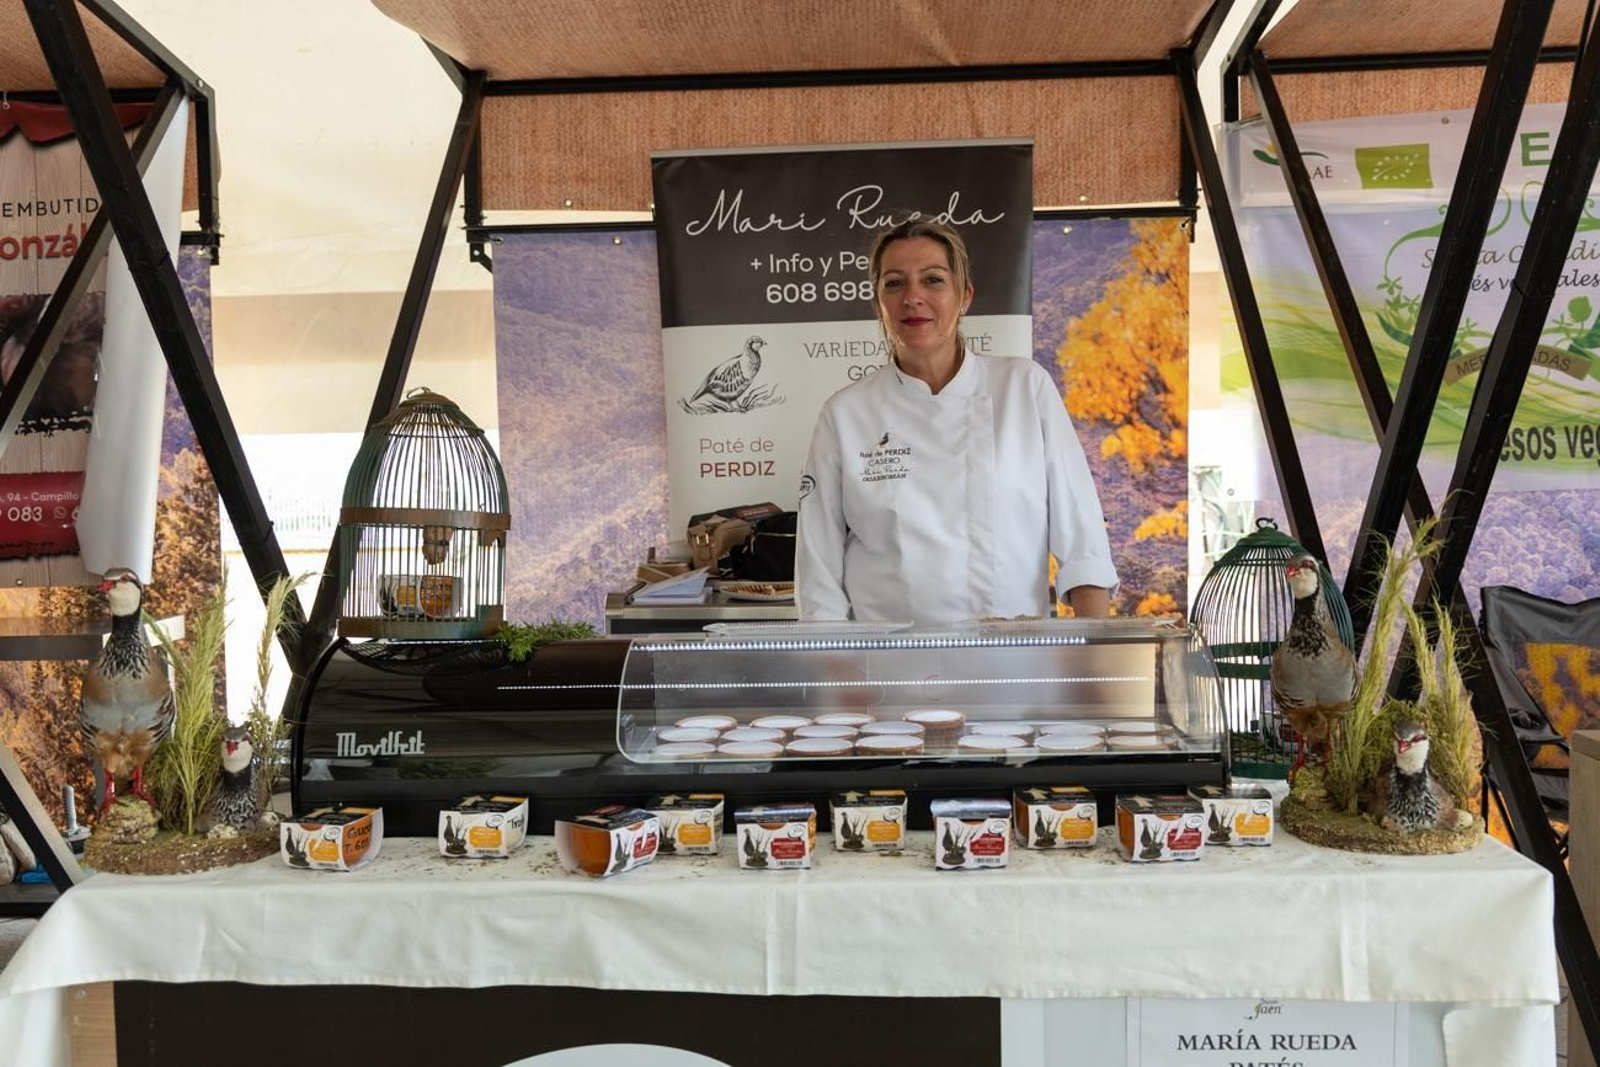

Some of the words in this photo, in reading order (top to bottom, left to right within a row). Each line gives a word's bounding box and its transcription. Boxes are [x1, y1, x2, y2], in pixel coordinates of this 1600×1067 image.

[1312, 165, 1333, 179] AE
[2, 198, 99, 217] EMBUTID
[686, 188, 826, 236] Mari
[0, 221, 87, 260] onzá
[769, 252, 814, 273] Info
[820, 256, 833, 277] y
[840, 251, 869, 271] Pe
[766, 283, 817, 303] 608
[824, 281, 875, 301] 698
[700, 438, 744, 453] Paté
[750, 437, 774, 452] de
[700, 461, 775, 478] PERDIZ
[868, 457, 901, 467] CASERO
[7, 506, 43, 522] 083
[335, 730, 426, 757] Movilfrit
[1177, 1028, 1261, 1051] MARÍA
[1270, 1034, 1358, 1051] RUEDA
